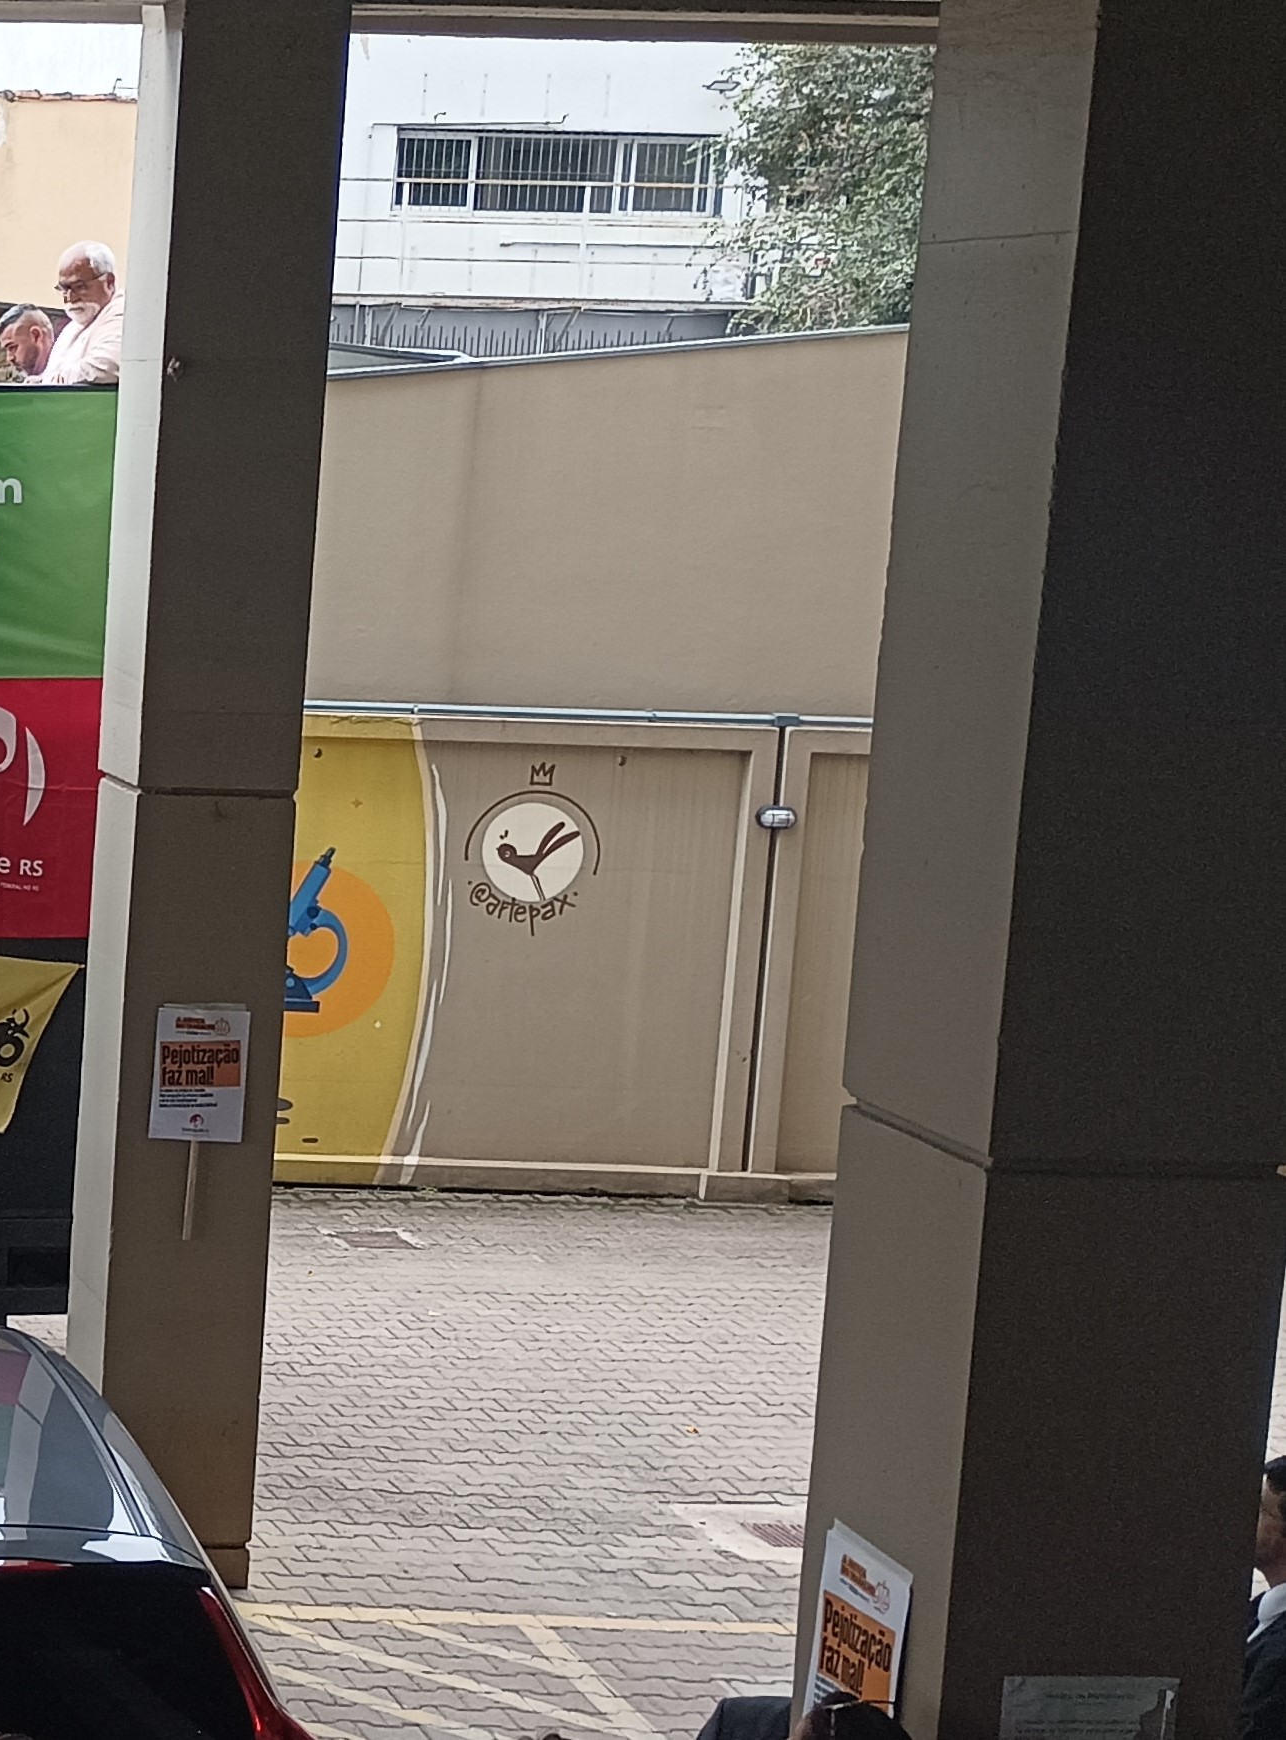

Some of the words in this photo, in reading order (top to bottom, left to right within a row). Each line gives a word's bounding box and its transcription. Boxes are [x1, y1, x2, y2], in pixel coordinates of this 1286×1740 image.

[19, 859, 44, 877] RS
[470, 881, 577, 936] @artepax
[161, 1044, 240, 1068] Pejotização
[0, 1071, 15, 1083] RS
[162, 1066, 183, 1086] faz
[823, 1596, 893, 1672] Pejotização
